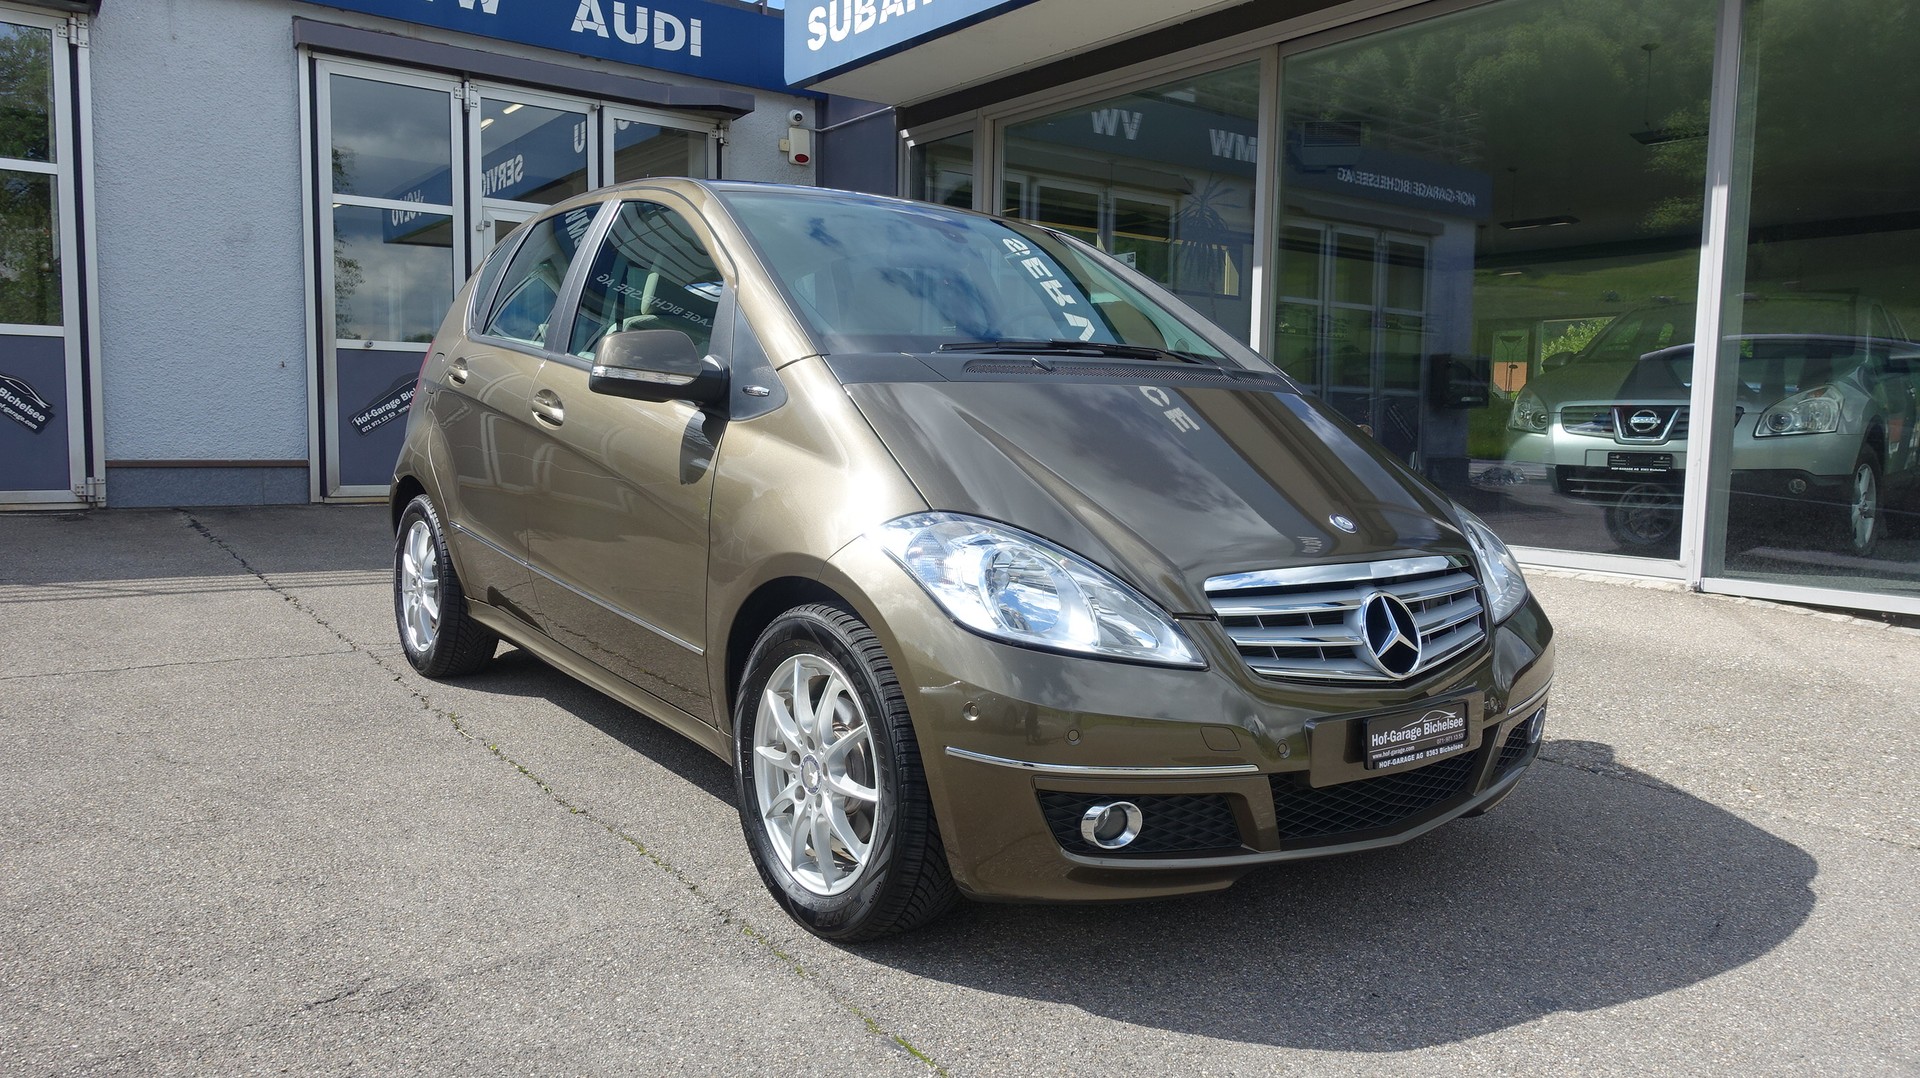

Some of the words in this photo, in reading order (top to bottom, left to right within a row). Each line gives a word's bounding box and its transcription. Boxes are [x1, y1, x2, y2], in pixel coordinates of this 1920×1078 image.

[570, 0, 702, 57] AUDI
[353, 397, 401, 426] Hof-Garage
[400, 387, 417, 402] Bic
[1371, 726, 1421, 747] Hof-Garage
[1423, 717, 1464, 735] Bichelsee
[1372, 745, 1415, 760] www.hof-garage.com
[1379, 754, 1415, 769] HOF-GARAGE
[1416, 752, 1424, 761] AG
[1439, 743, 1464, 754] Bichelsee
